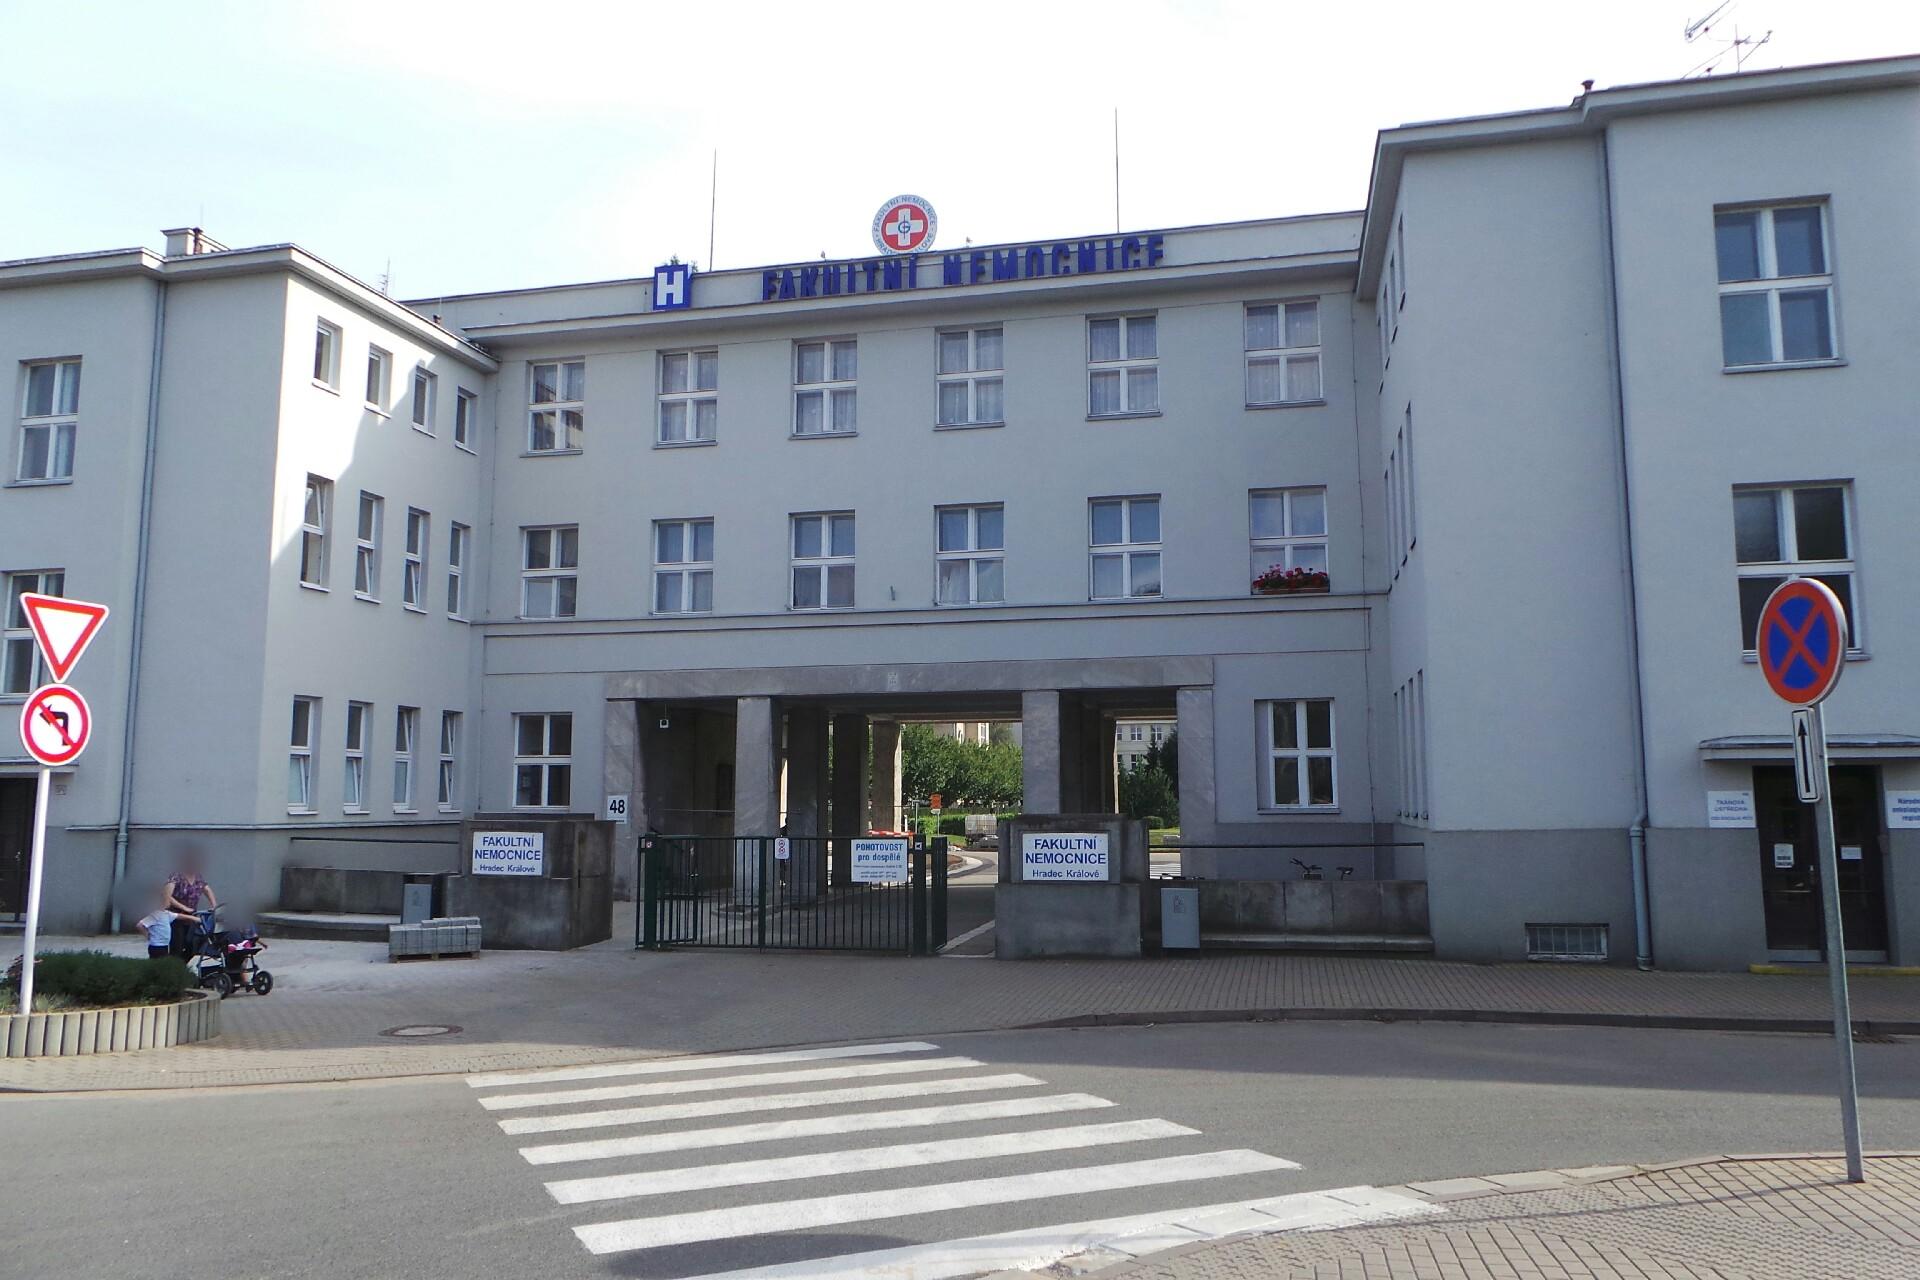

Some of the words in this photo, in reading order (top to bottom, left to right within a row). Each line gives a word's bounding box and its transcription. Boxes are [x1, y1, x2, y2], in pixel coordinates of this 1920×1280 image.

[943, 234, 1164, 286] NEMOCNICE
[656, 270, 684, 306] H
[609, 799, 625, 814] 48
[482, 834, 535, 847] FAKULTNÍ
[1034, 835, 1097, 850] FAKULTNÍ
[855, 843, 904, 851] POHOTOVOST
[474, 849, 541, 861] NEMOCNICE
[857, 854, 870, 862] pro
[872, 852, 901, 862] dospělé
[1025, 852, 1107, 864] NEMOCNICE
[479, 864, 505, 872] Hradec
[507, 864, 536, 873] Králové
[1032, 869, 1063, 878] Hradec
[1066, 869, 1100, 878] Králové
